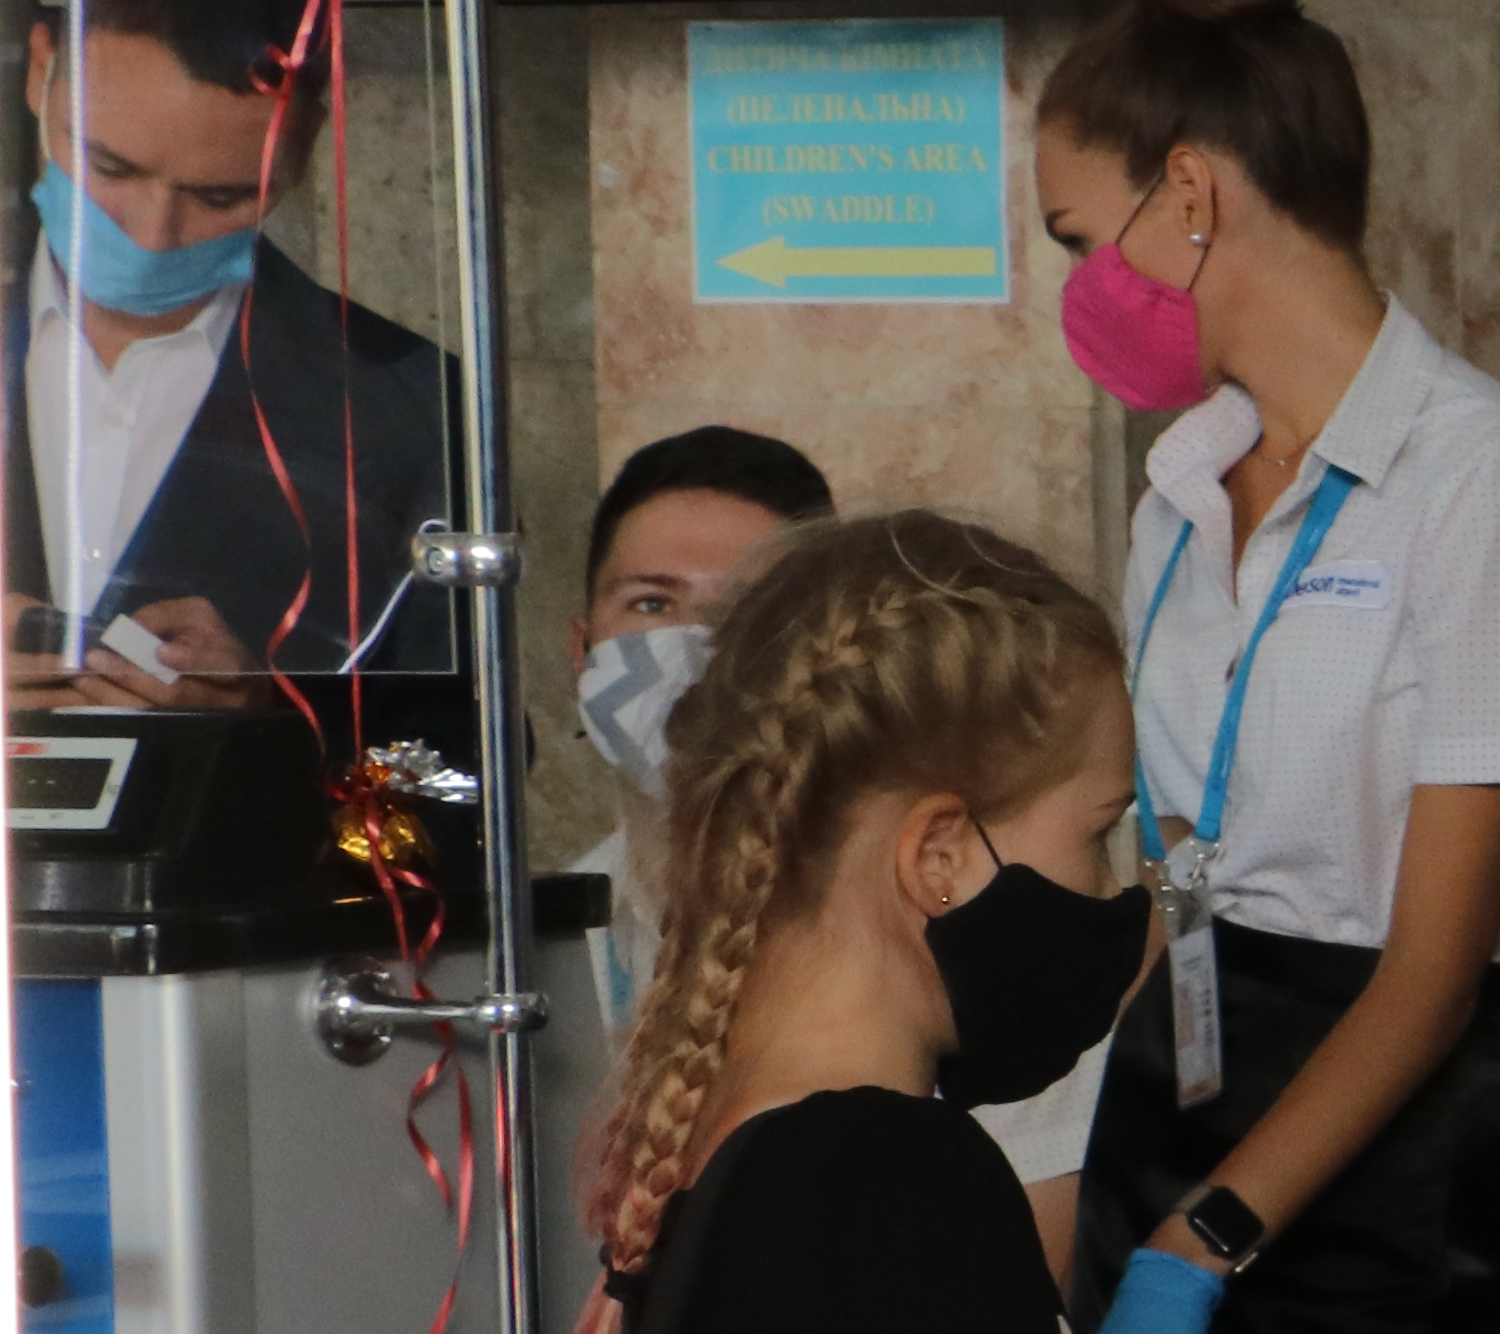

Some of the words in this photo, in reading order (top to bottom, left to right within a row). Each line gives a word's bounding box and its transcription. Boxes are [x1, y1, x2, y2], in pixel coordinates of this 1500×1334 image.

[706, 143, 896, 174] CHILDREN'S
[904, 142, 988, 171] AREA
[761, 194, 936, 226] (SWADDLE)
